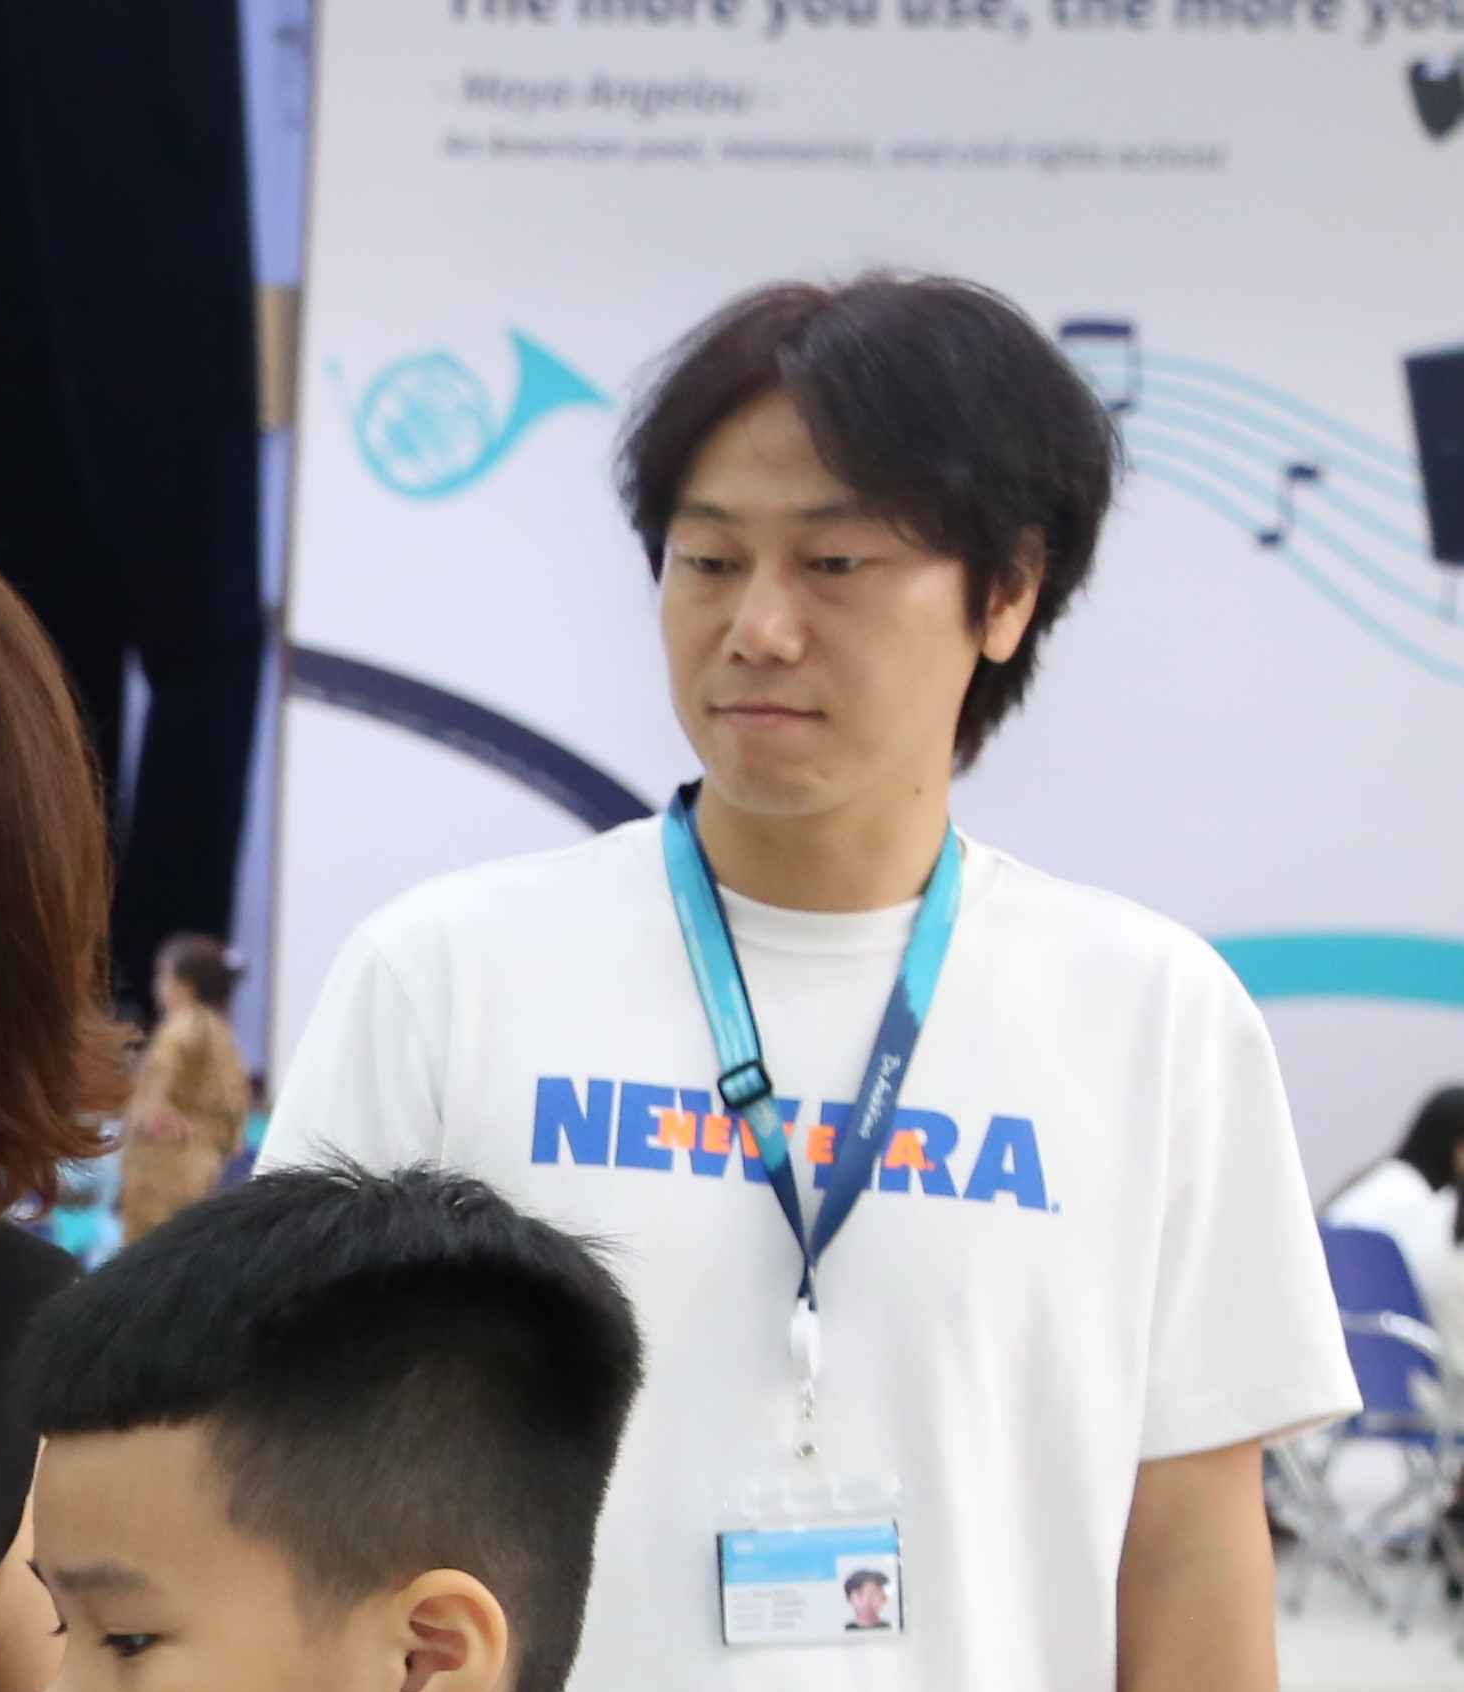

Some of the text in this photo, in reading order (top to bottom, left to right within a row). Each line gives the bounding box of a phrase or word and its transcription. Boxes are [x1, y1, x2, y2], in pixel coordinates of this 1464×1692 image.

[576, 0, 743, 28] more
[758, 0, 879, 41] you
[531, 1076, 803, 1187] NEW
[805, 1125, 934, 1172] EA
